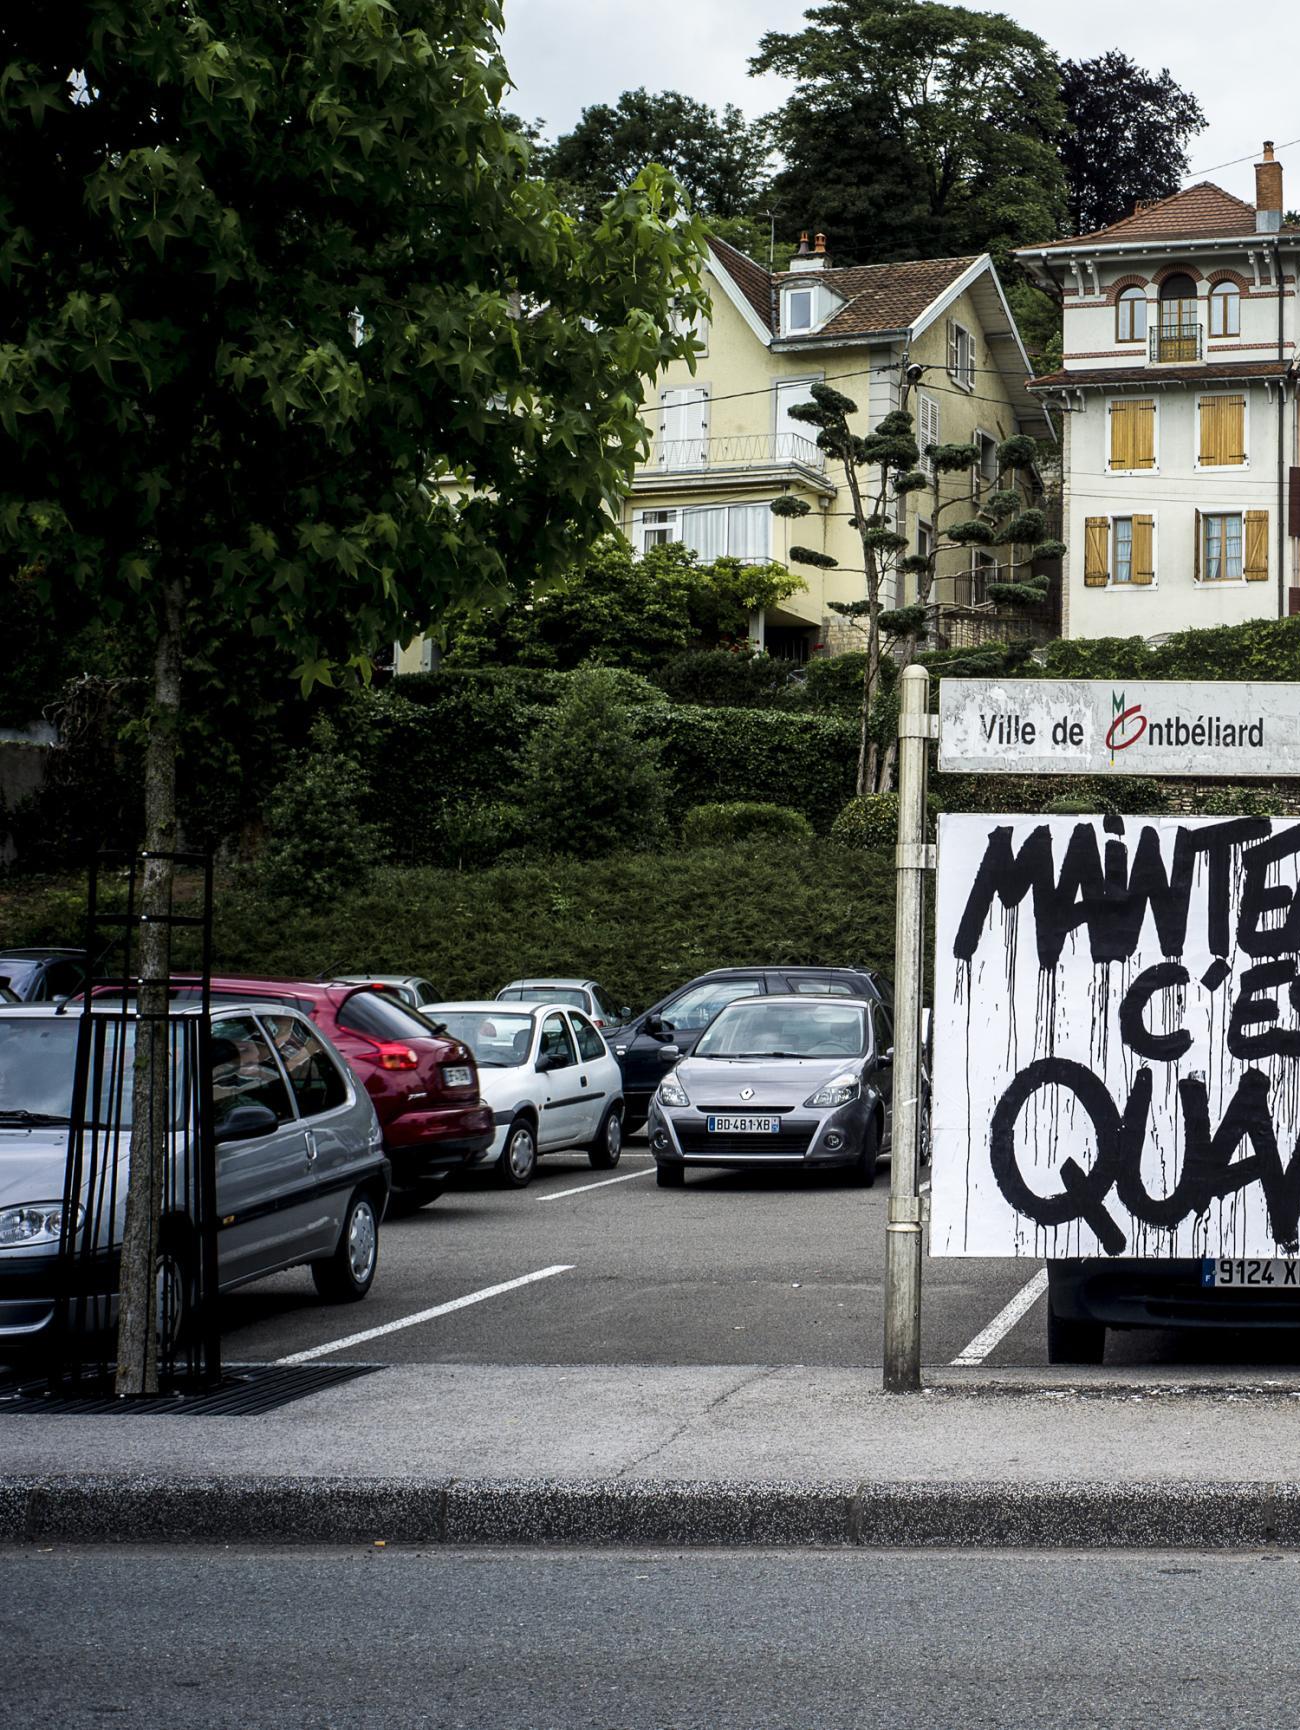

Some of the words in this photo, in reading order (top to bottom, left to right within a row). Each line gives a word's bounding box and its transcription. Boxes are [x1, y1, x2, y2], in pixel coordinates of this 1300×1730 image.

[979, 714, 1036, 745] Ville
[1051, 715, 1084, 746] de
[1219, 1260, 1275, 1285] 9124
